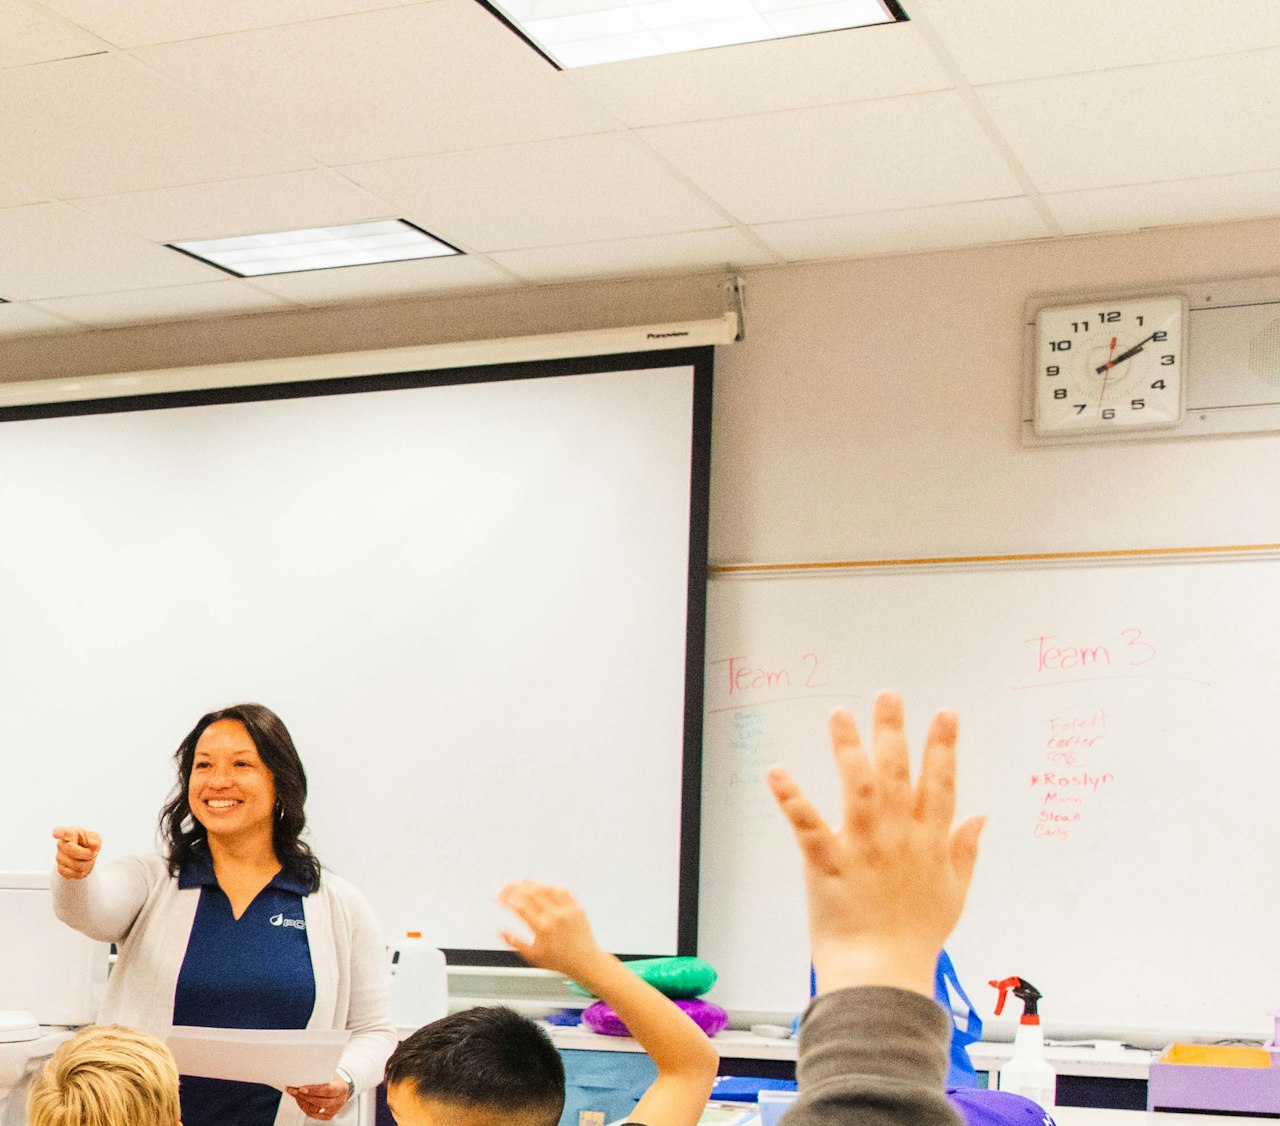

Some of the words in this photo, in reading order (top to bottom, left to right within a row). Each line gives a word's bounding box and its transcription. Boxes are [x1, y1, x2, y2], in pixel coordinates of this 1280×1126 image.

[1099, 311, 1121, 323] 12
[1136, 316, 1144, 326] 1
[1071, 321, 1089, 333] 11
[1151, 330, 1168, 342] 2
[1049, 340, 1071, 351] 10
[1160, 354, 1175, 366] 3
[1046, 366, 1060, 377] 9
[1150, 379, 1166, 390] 4
[1053, 388, 1067, 400] 8
[1072, 403, 1087, 415] 7
[1131, 399, 1145, 410] 5
[1101, 408, 1115, 420] 6
[1025, 636, 1111, 672] Team
[1120, 628, 1157, 666] 3
[709, 656, 791, 695] Team
[802, 653, 830, 688] 2
[1043, 772, 1115, 792] Roslyn
